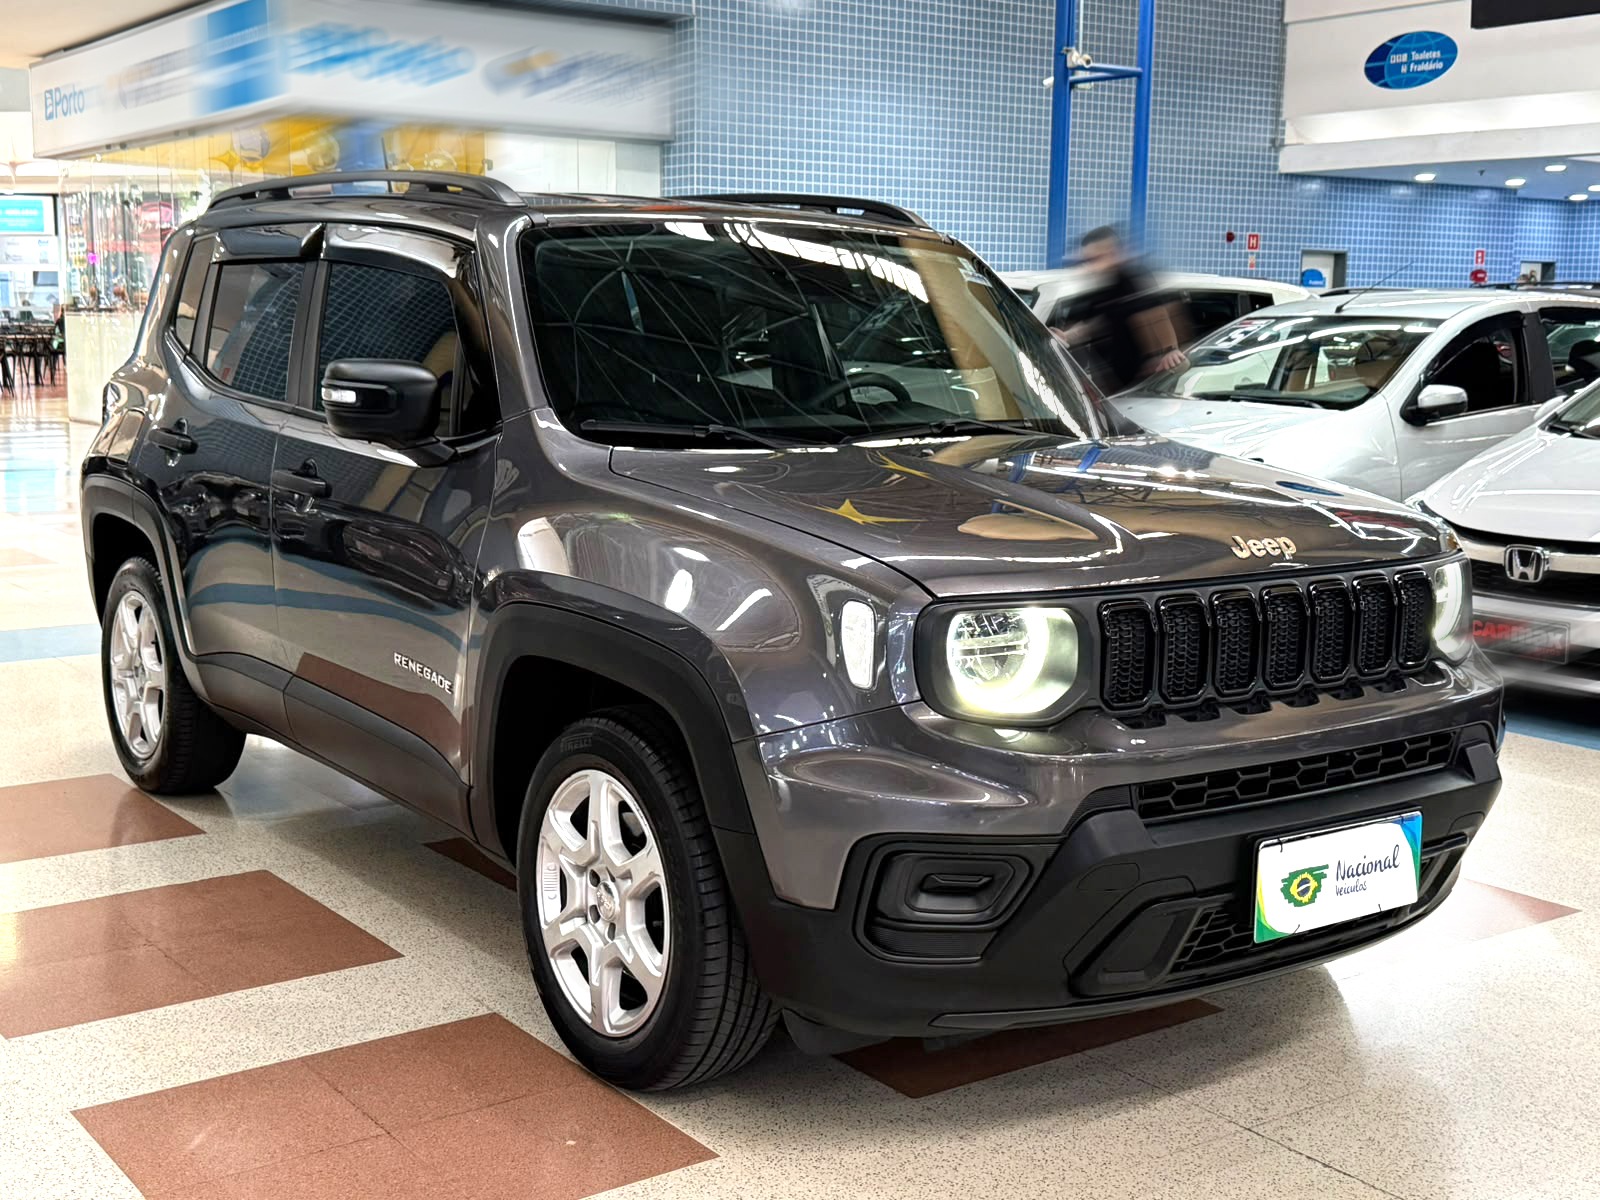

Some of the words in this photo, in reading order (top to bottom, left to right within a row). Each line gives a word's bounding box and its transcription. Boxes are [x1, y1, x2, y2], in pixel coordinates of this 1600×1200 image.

[1410, 60, 1444, 72] Fraldário
[1411, 50, 1441, 60] Toaletes
[54, 83, 85, 119] Porto
[1230, 535, 1297, 560] Jeep
[393, 652, 452, 695] RENEGADE
[1336, 844, 1400, 882] Nacional
